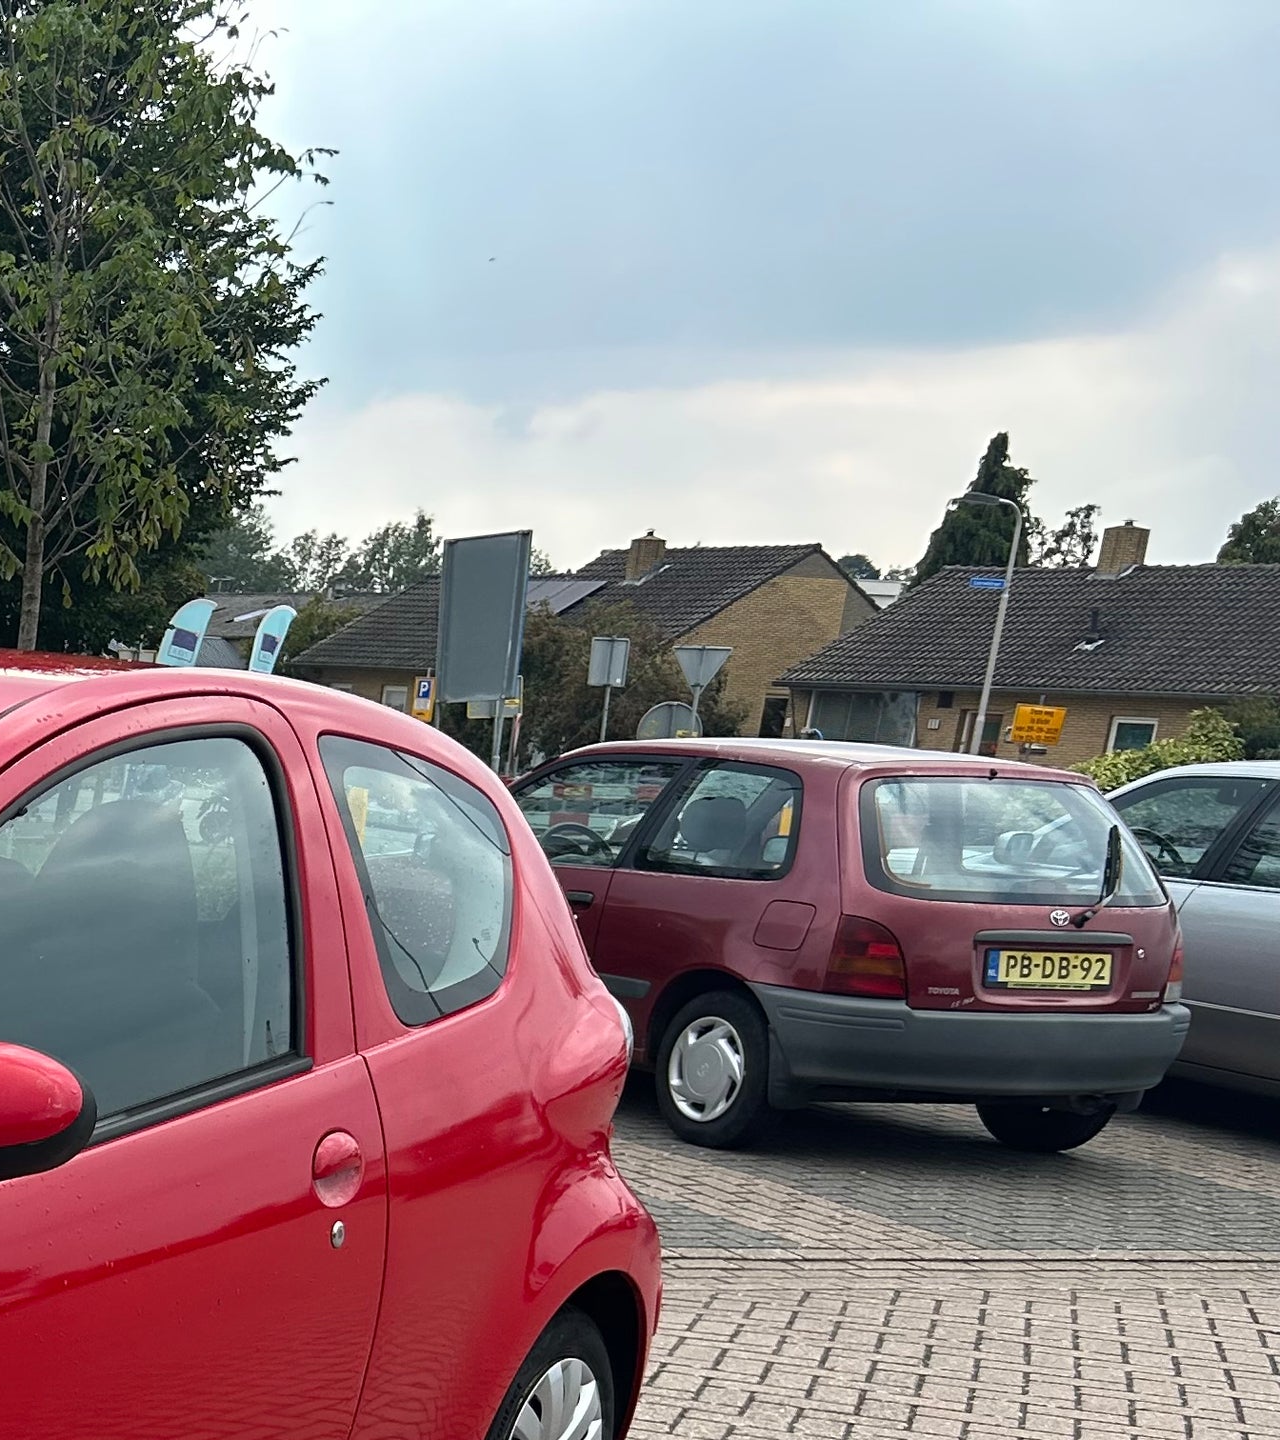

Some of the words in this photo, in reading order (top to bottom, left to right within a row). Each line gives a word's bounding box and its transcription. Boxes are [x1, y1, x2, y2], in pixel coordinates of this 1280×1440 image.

[419, 682, 429, 697] P
[1005, 955, 1106, 980] PB-DB-92
[927, 986, 960, 995] TOYOTA
